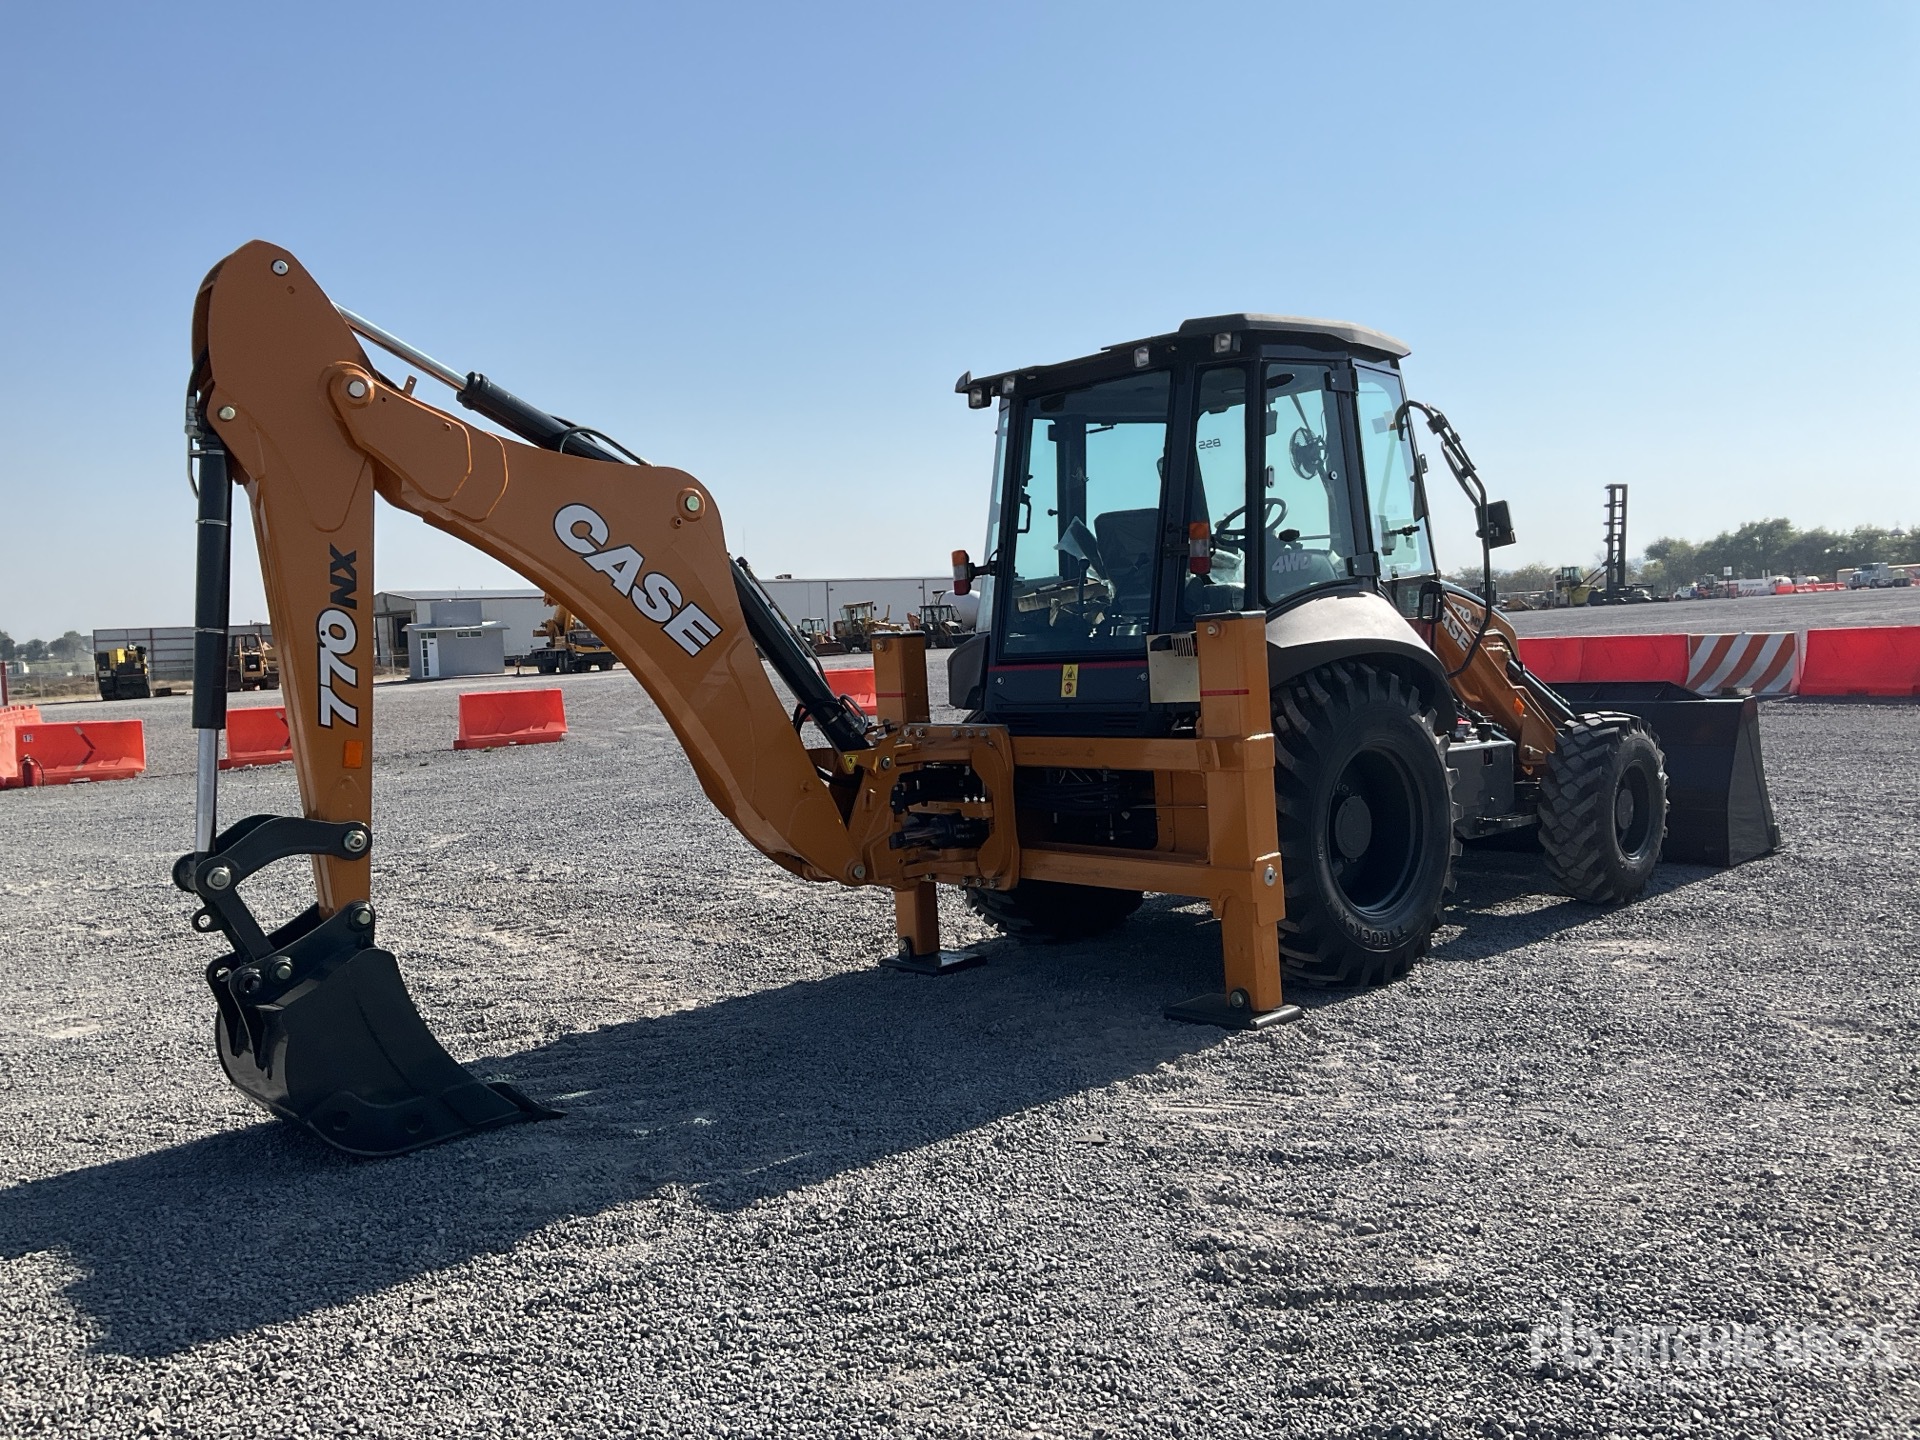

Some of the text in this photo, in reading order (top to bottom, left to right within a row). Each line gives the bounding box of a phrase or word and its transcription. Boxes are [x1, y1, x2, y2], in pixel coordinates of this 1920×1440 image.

[553, 503, 723, 658] CASE
[1271, 552, 1312, 574] 4WD
[1442, 607, 1470, 651] ASE
